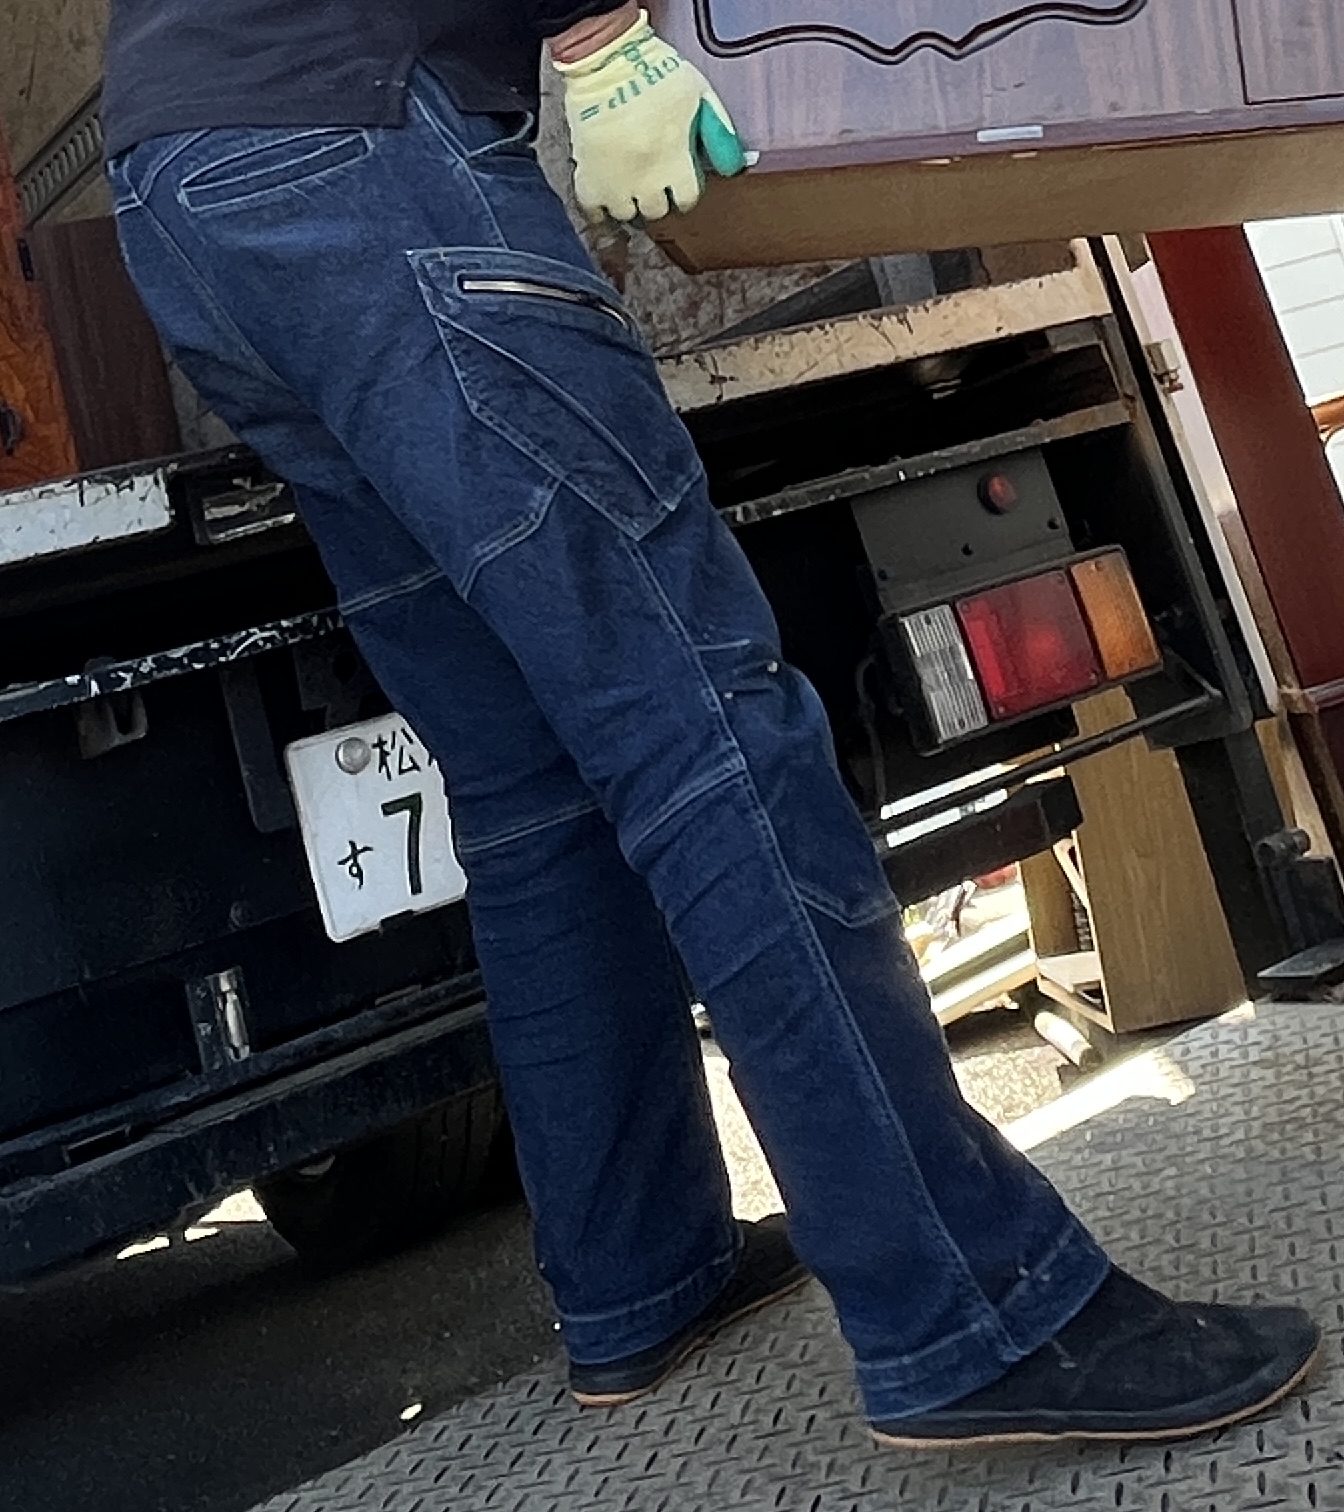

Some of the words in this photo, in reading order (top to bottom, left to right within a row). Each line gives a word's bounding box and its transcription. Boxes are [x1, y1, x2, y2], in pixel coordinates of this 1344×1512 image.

[371, 726, 433, 782] 松
[336, 840, 375, 890] す
[380, 791, 423, 896] 7
